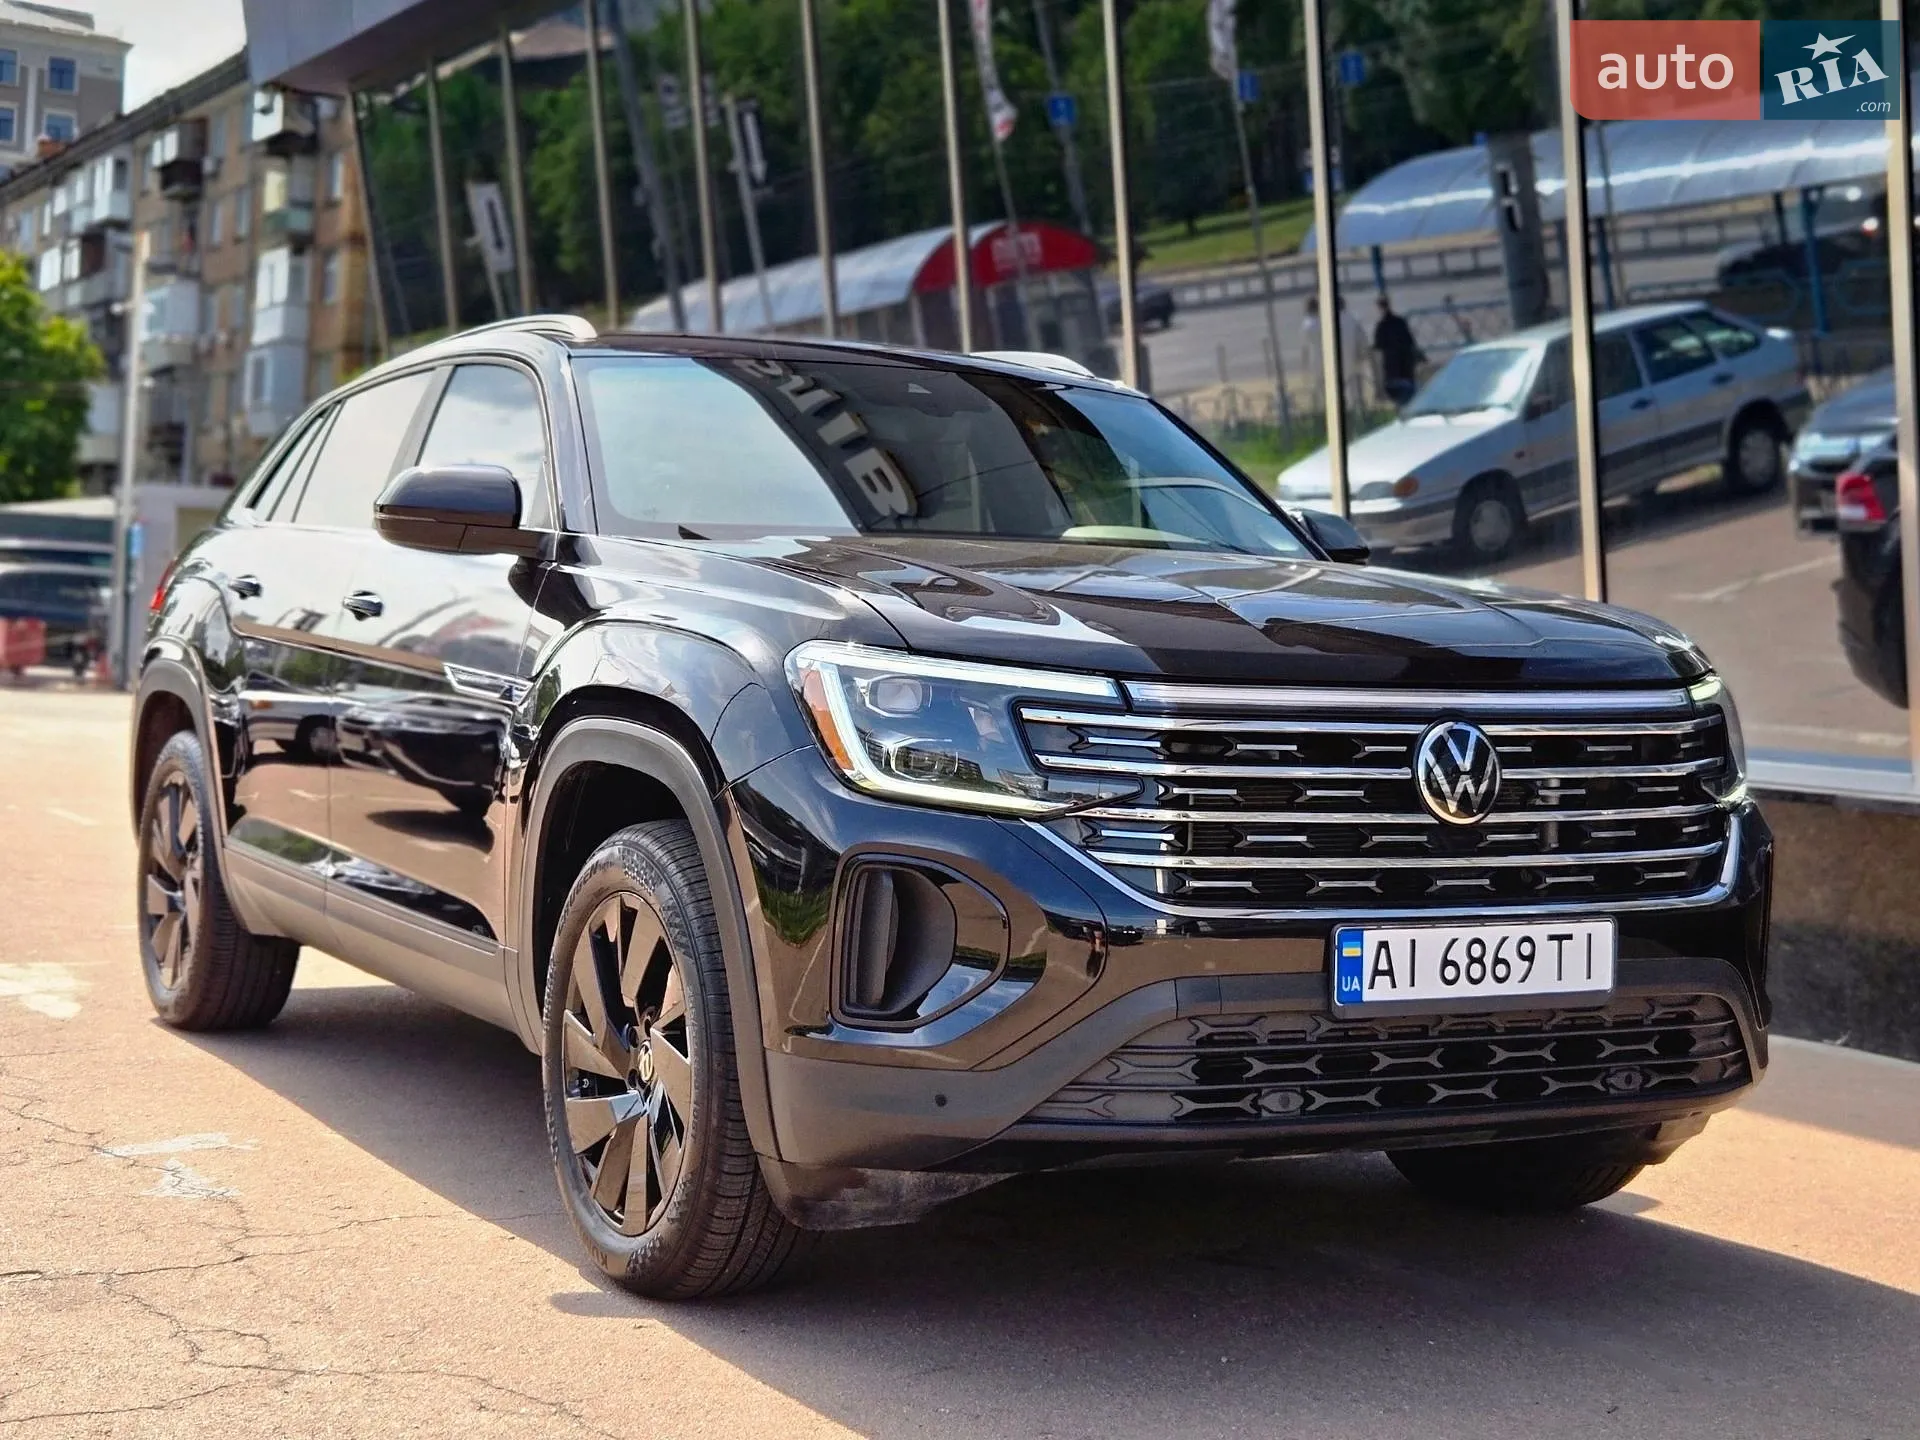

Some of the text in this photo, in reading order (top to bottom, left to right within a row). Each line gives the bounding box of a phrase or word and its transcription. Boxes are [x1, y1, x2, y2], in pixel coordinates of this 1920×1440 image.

[1367, 932, 1593, 990] AI 6869 TI
[1342, 976, 1361, 992] UA
